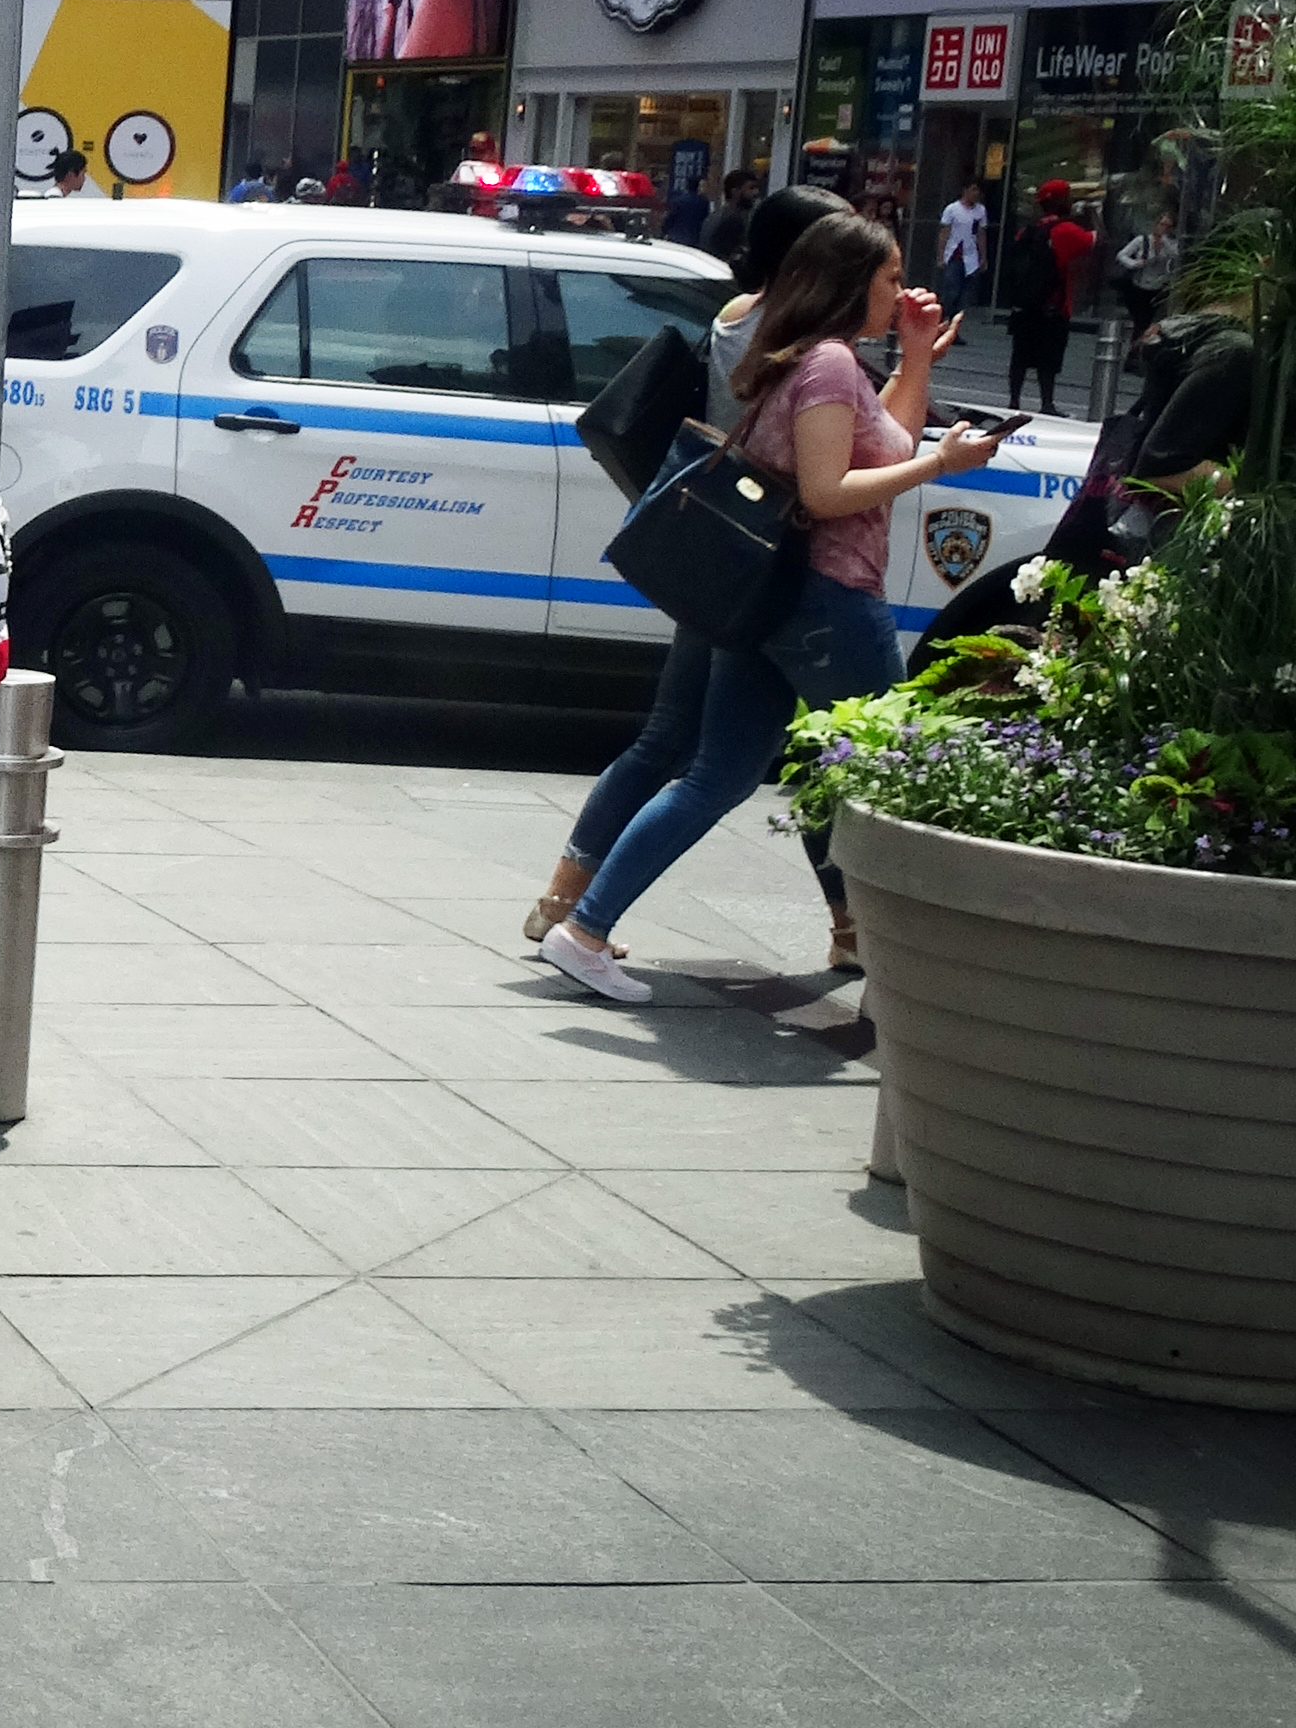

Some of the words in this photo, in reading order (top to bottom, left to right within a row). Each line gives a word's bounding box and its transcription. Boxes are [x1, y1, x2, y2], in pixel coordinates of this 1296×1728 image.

[974, 32, 1002, 56] UNI
[971, 58, 1001, 82] QLO
[1035, 43, 1127, 80] LifeWear
[74, 384, 114, 413] SRG
[123, 389, 135, 415] 5
